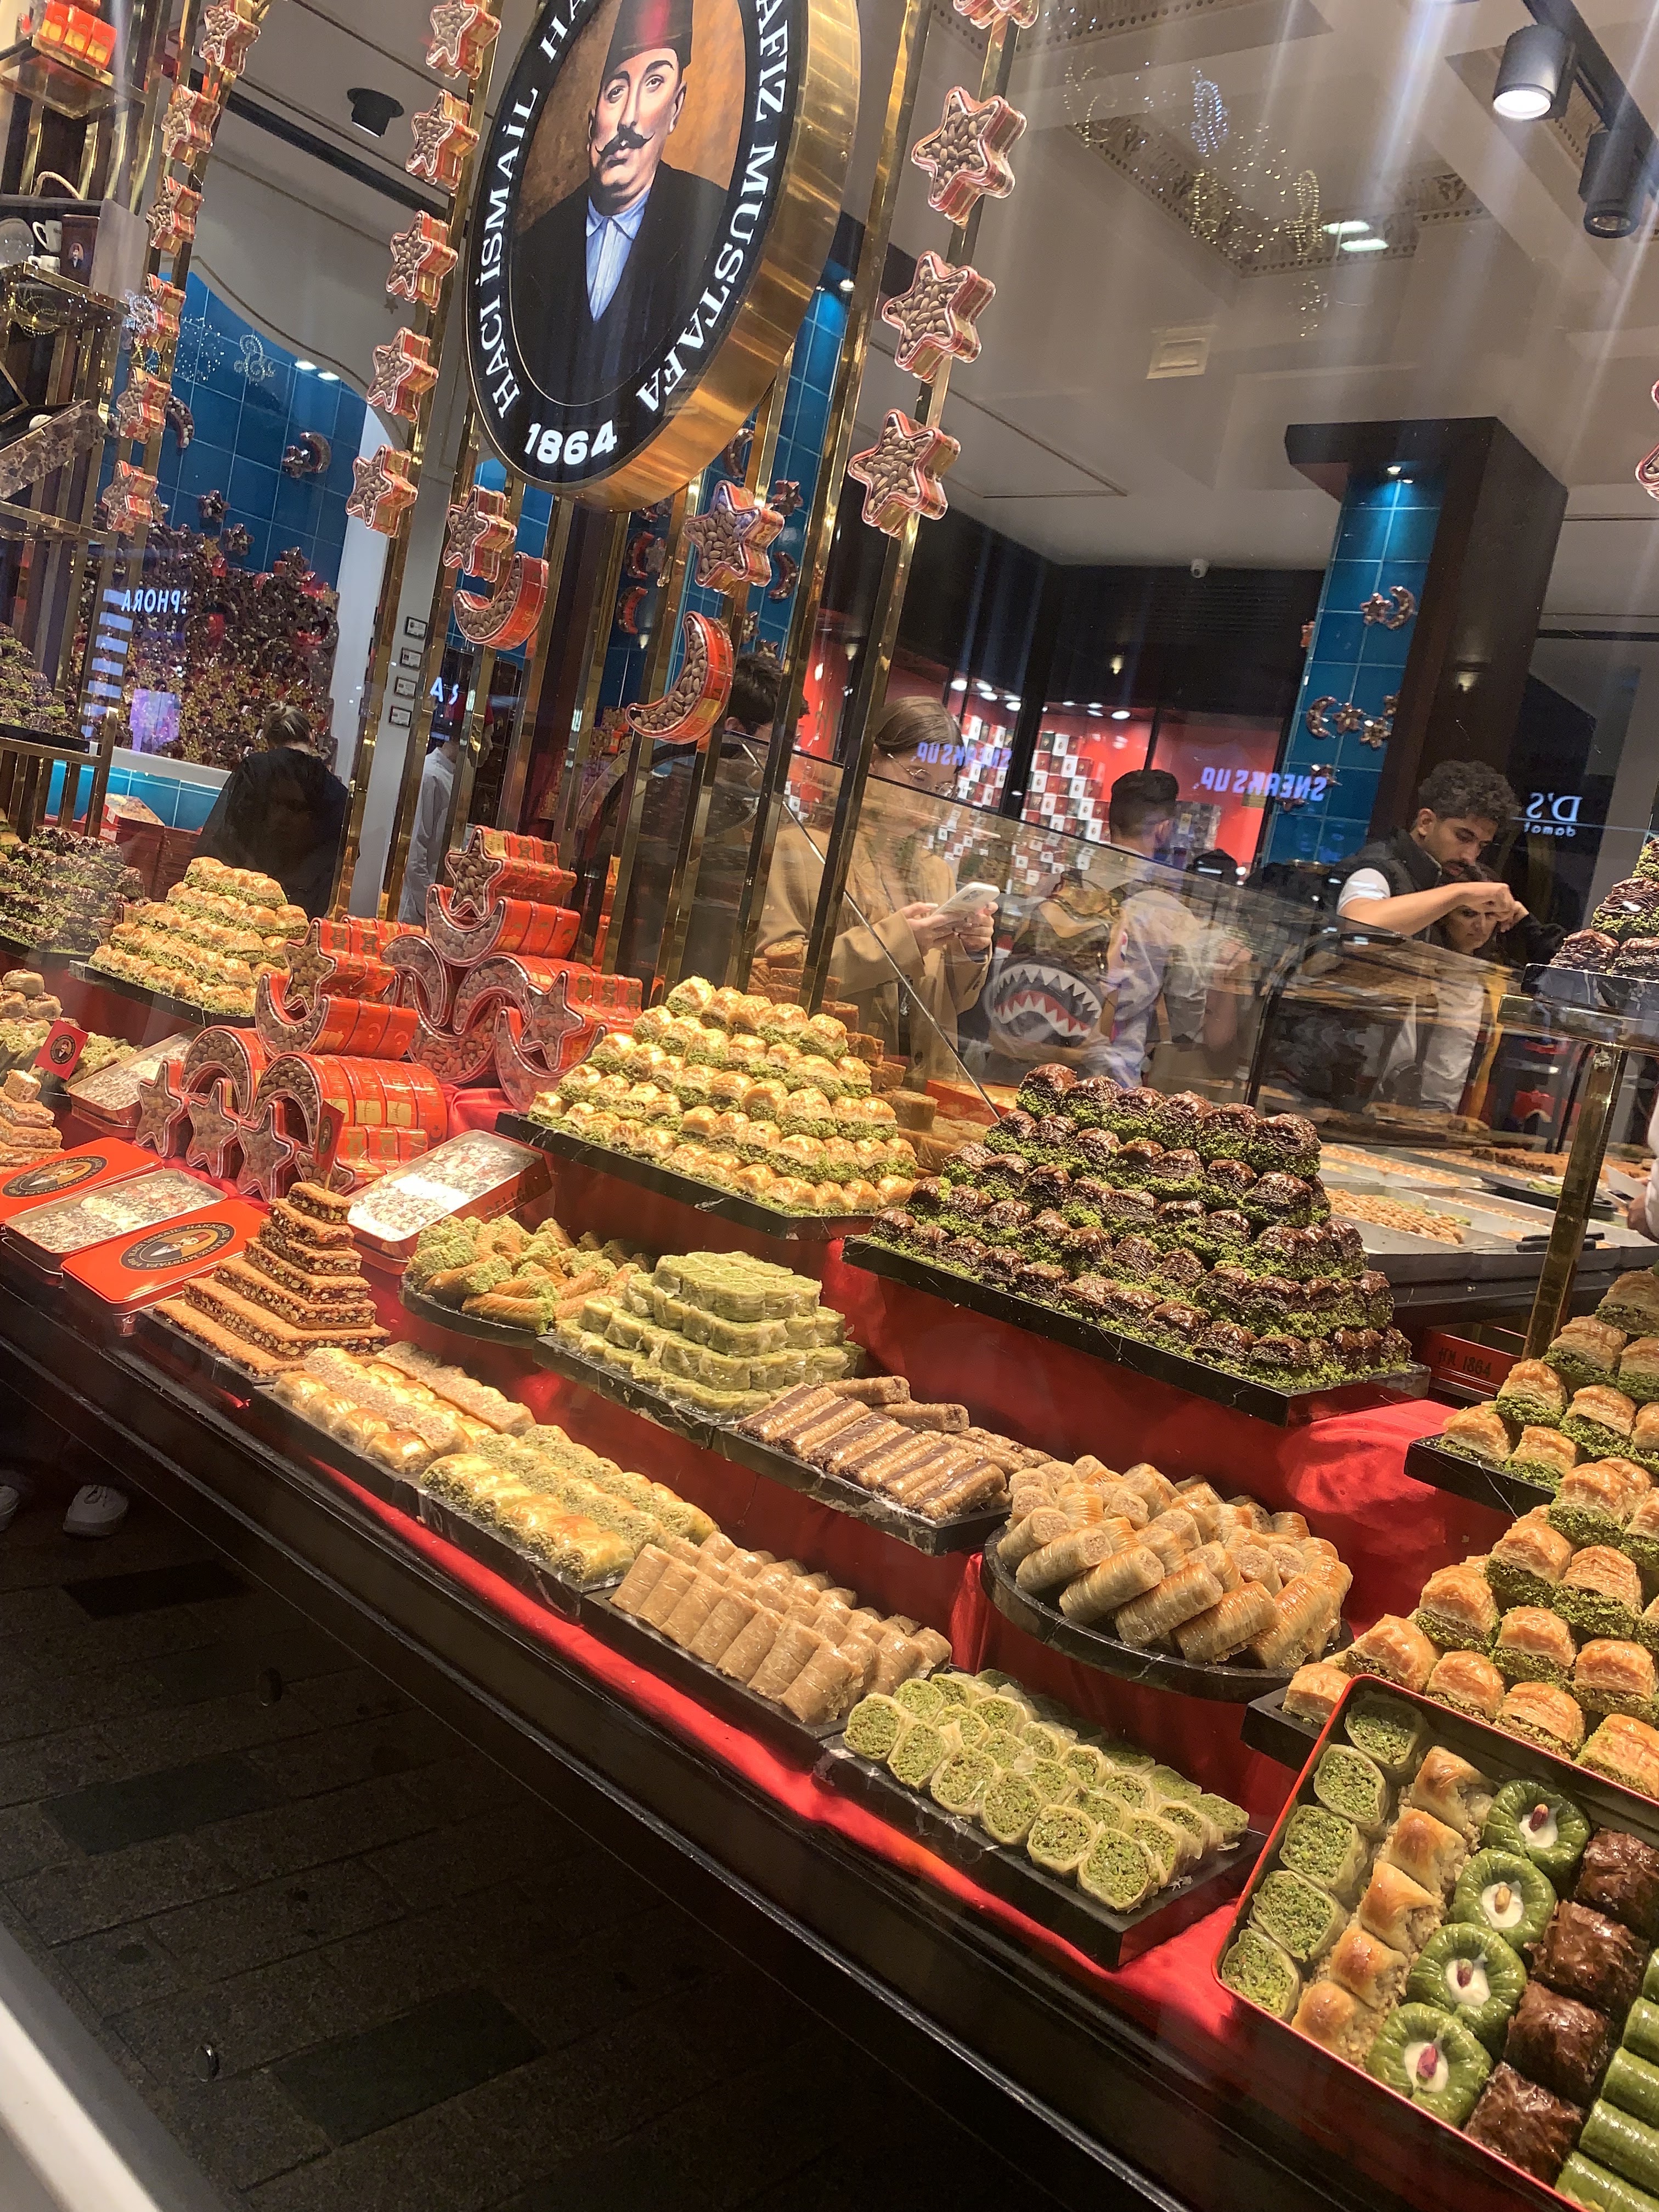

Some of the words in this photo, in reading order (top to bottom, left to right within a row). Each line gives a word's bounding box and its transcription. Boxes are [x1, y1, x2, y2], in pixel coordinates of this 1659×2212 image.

[475, 87, 539, 286] İSMAİL
[635, 140, 778, 412] MUSTAFA
[479, 295, 520, 419] HACI
[524, 420, 618, 465] 1864
